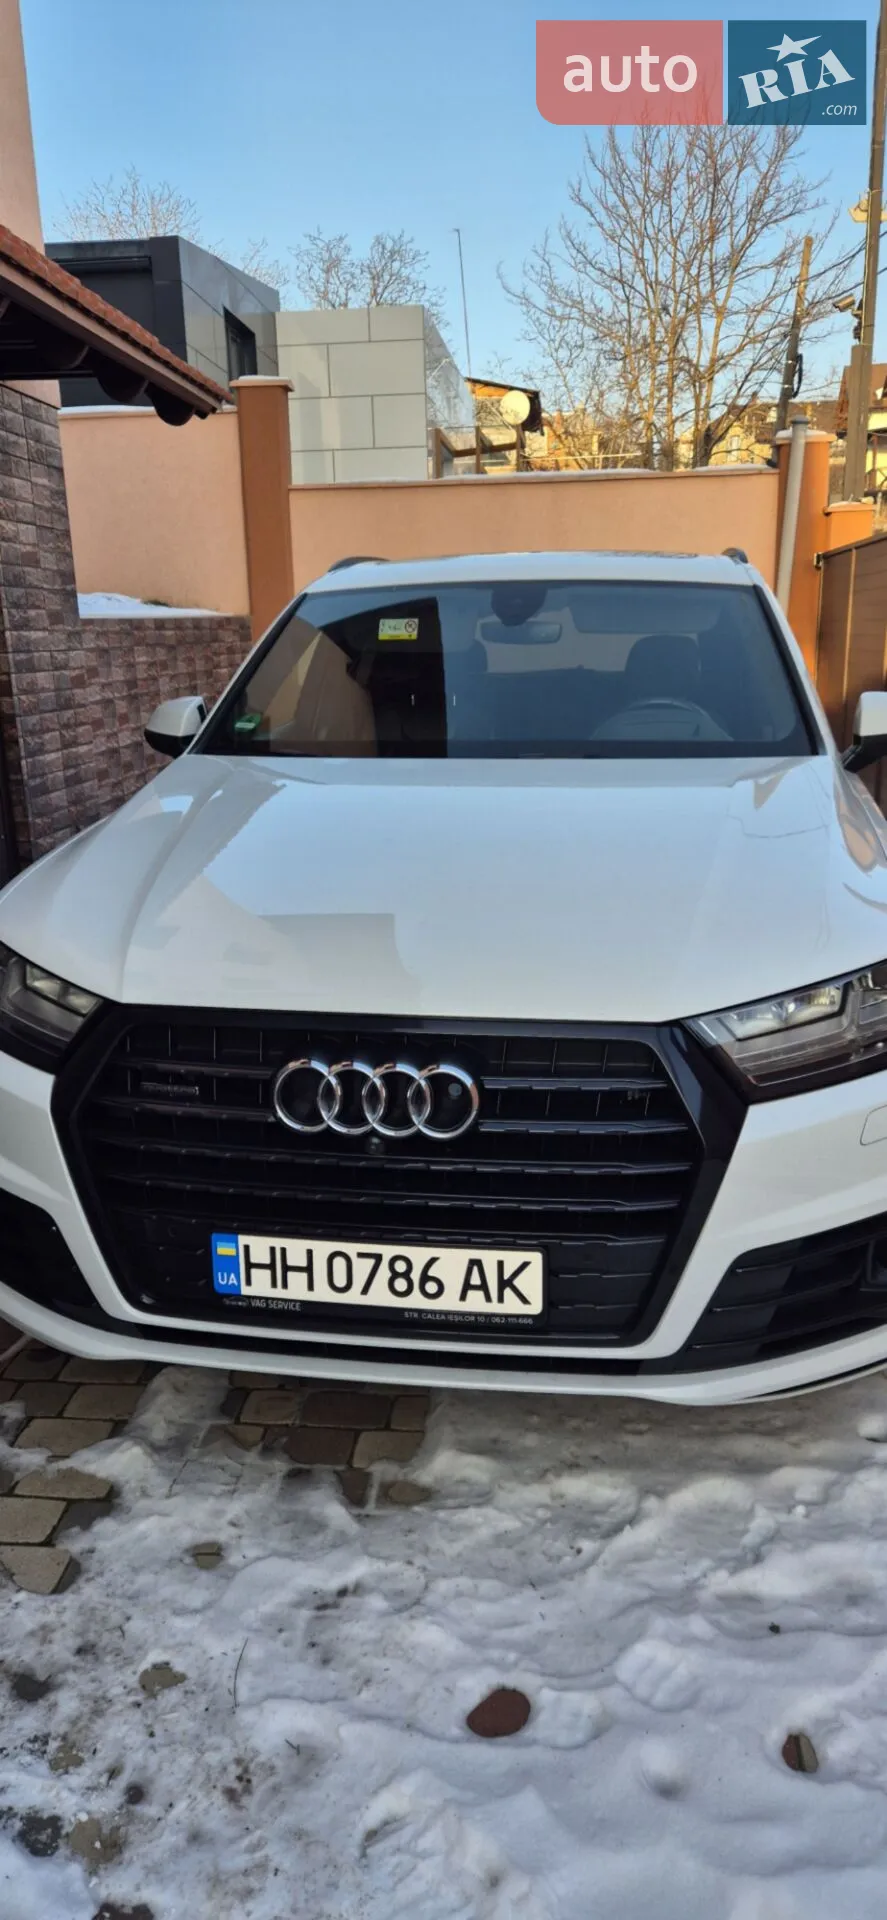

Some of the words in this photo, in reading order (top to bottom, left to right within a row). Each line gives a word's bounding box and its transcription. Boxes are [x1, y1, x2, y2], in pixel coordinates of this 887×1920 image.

[217, 1271, 239, 1287] UA
[243, 1244, 315, 1292] HH
[326, 1250, 446, 1300] 0786
[458, 1257, 533, 1306] AK
[250, 1298, 267, 1309] VAG
[268, 1299, 302, 1312] SERVICE
[421, 1312, 446, 1321] CALEA
